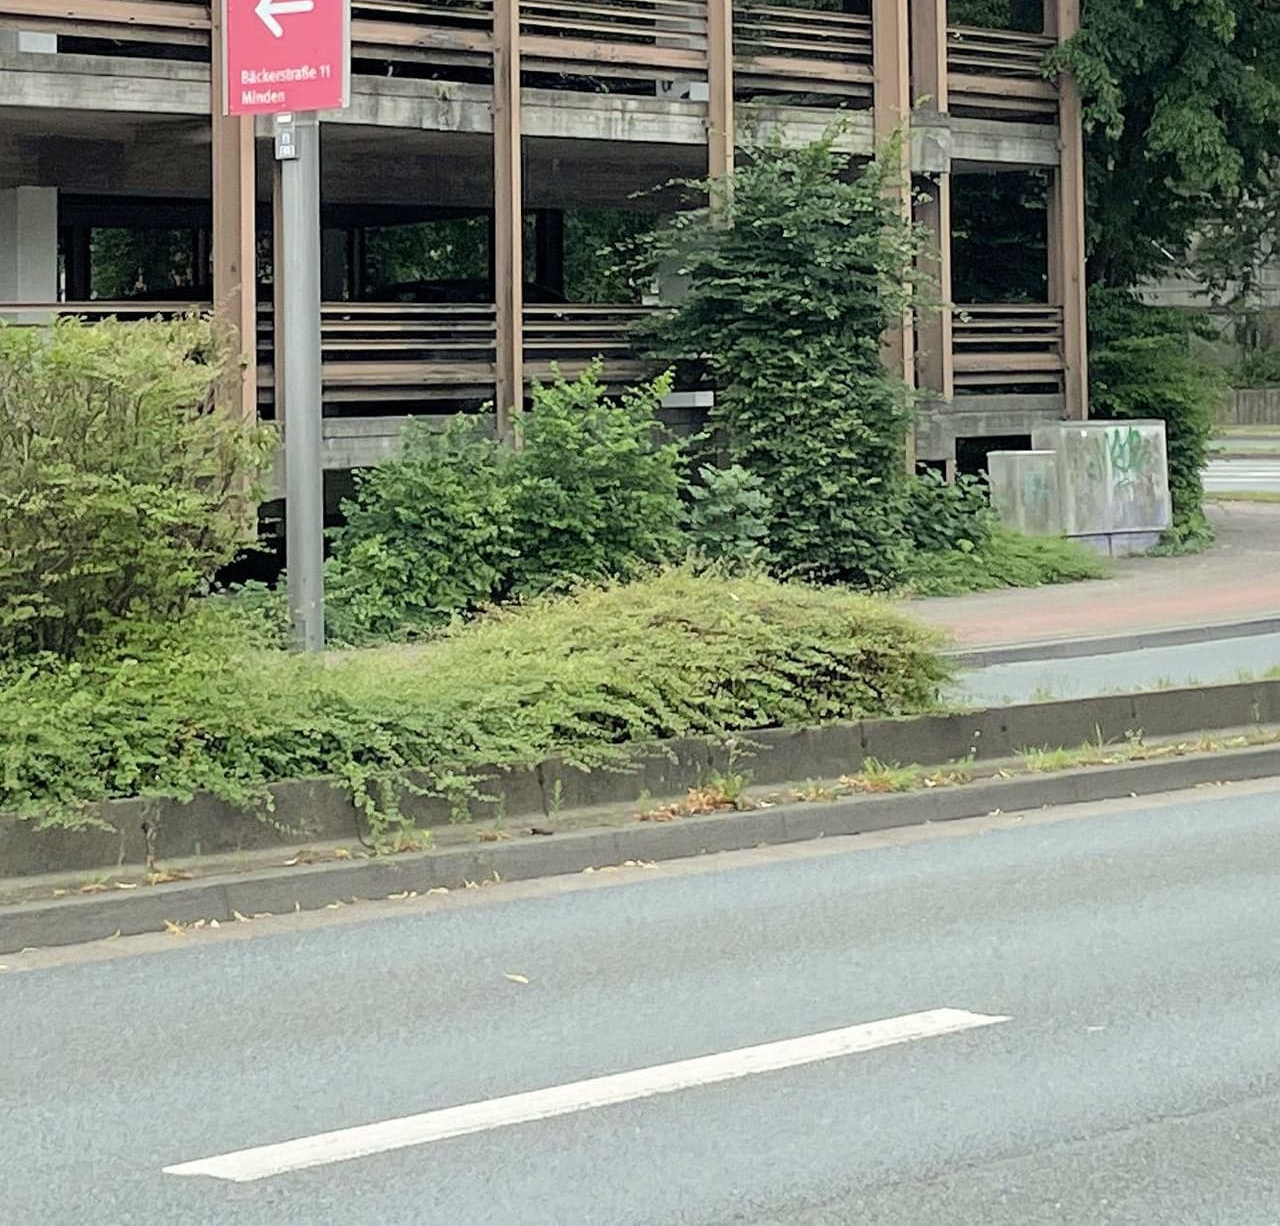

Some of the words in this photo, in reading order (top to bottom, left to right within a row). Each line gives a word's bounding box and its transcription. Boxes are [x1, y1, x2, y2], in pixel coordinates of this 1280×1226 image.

[240, 65, 317, 85] Bäckerstraße
[319, 65, 331, 79] 11
[241, 89, 286, 105] Minden
